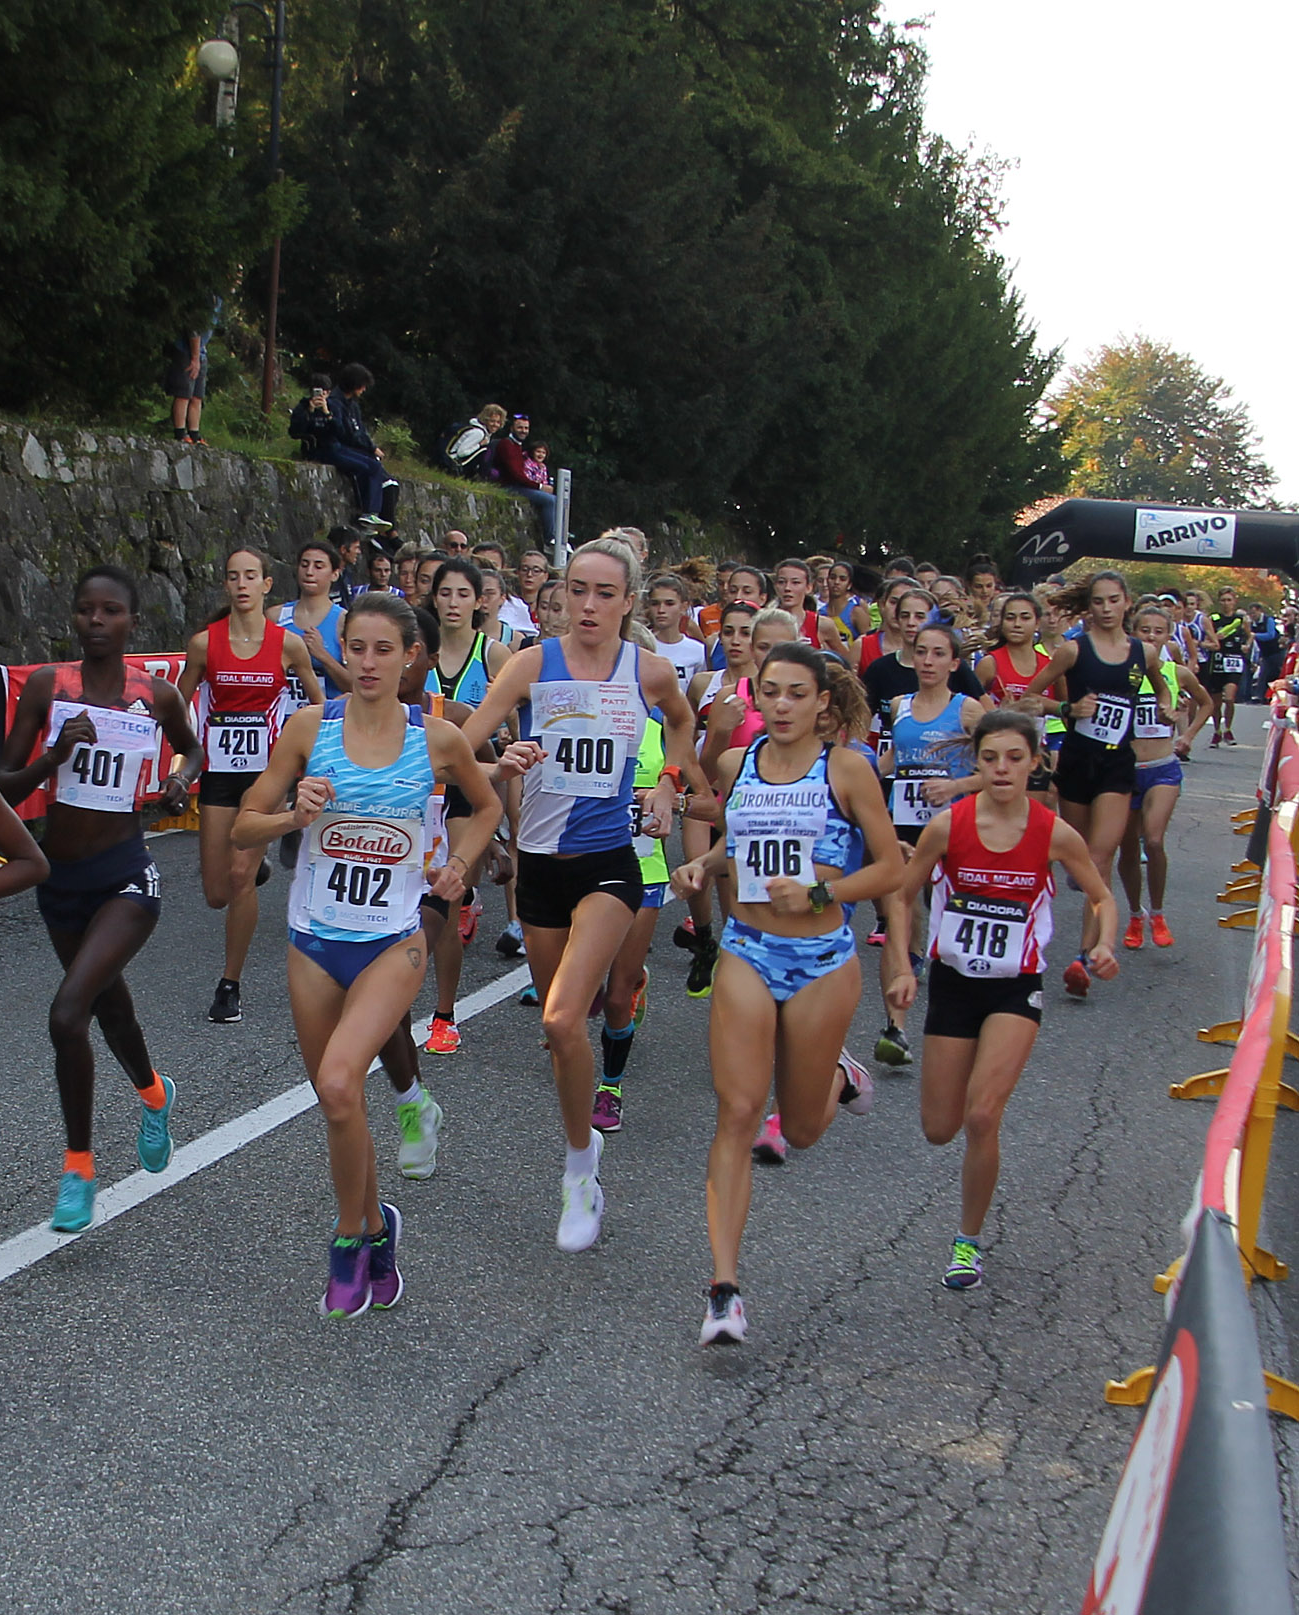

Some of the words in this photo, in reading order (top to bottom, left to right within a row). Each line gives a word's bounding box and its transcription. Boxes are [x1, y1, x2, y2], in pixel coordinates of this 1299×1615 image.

[1145, 516, 1227, 550] ARRIVO
[216, 674, 239, 683] FIDAL
[242, 675, 274, 684] MILANO
[601, 698, 628, 706] PATTI
[224, 715, 265, 723] DIADORA
[218, 729, 260, 756] 420
[72, 747, 126, 788] 401
[555, 737, 614, 775] 400
[324, 799, 362, 811] AMME
[904, 782, 943, 808] 44
[326, 831, 404, 855] Botalla
[747, 839, 801, 877] 406
[327, 862, 392, 908] 402
[957, 871, 990, 884] FIDAL
[993, 875, 1037, 887] MILANO
[966, 900, 1025, 917] DIADORA
[954, 918, 1010, 959] 418
